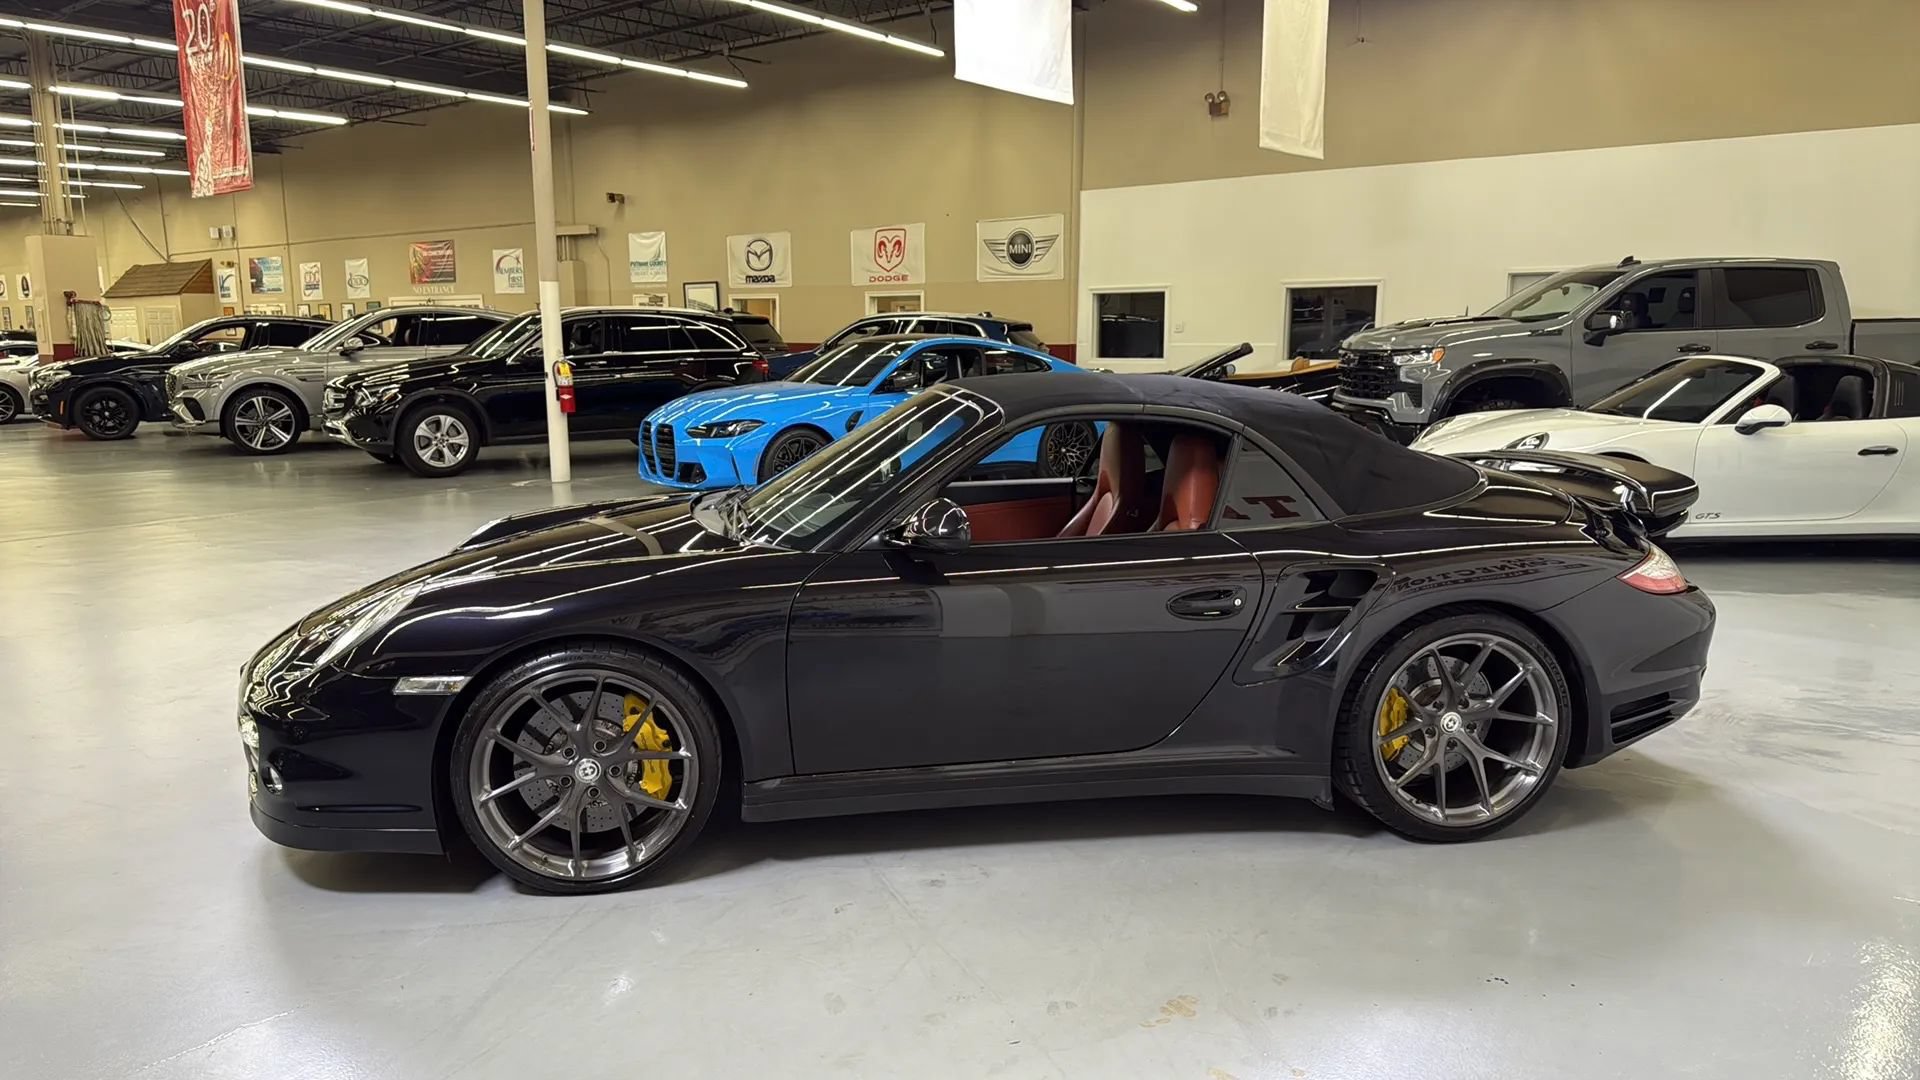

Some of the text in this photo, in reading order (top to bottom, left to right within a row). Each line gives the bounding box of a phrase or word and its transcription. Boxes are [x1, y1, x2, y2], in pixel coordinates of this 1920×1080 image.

[1008, 243, 1032, 255] MINI
[869, 274, 909, 283] DODGE
[1695, 512, 1721, 520] GTS
